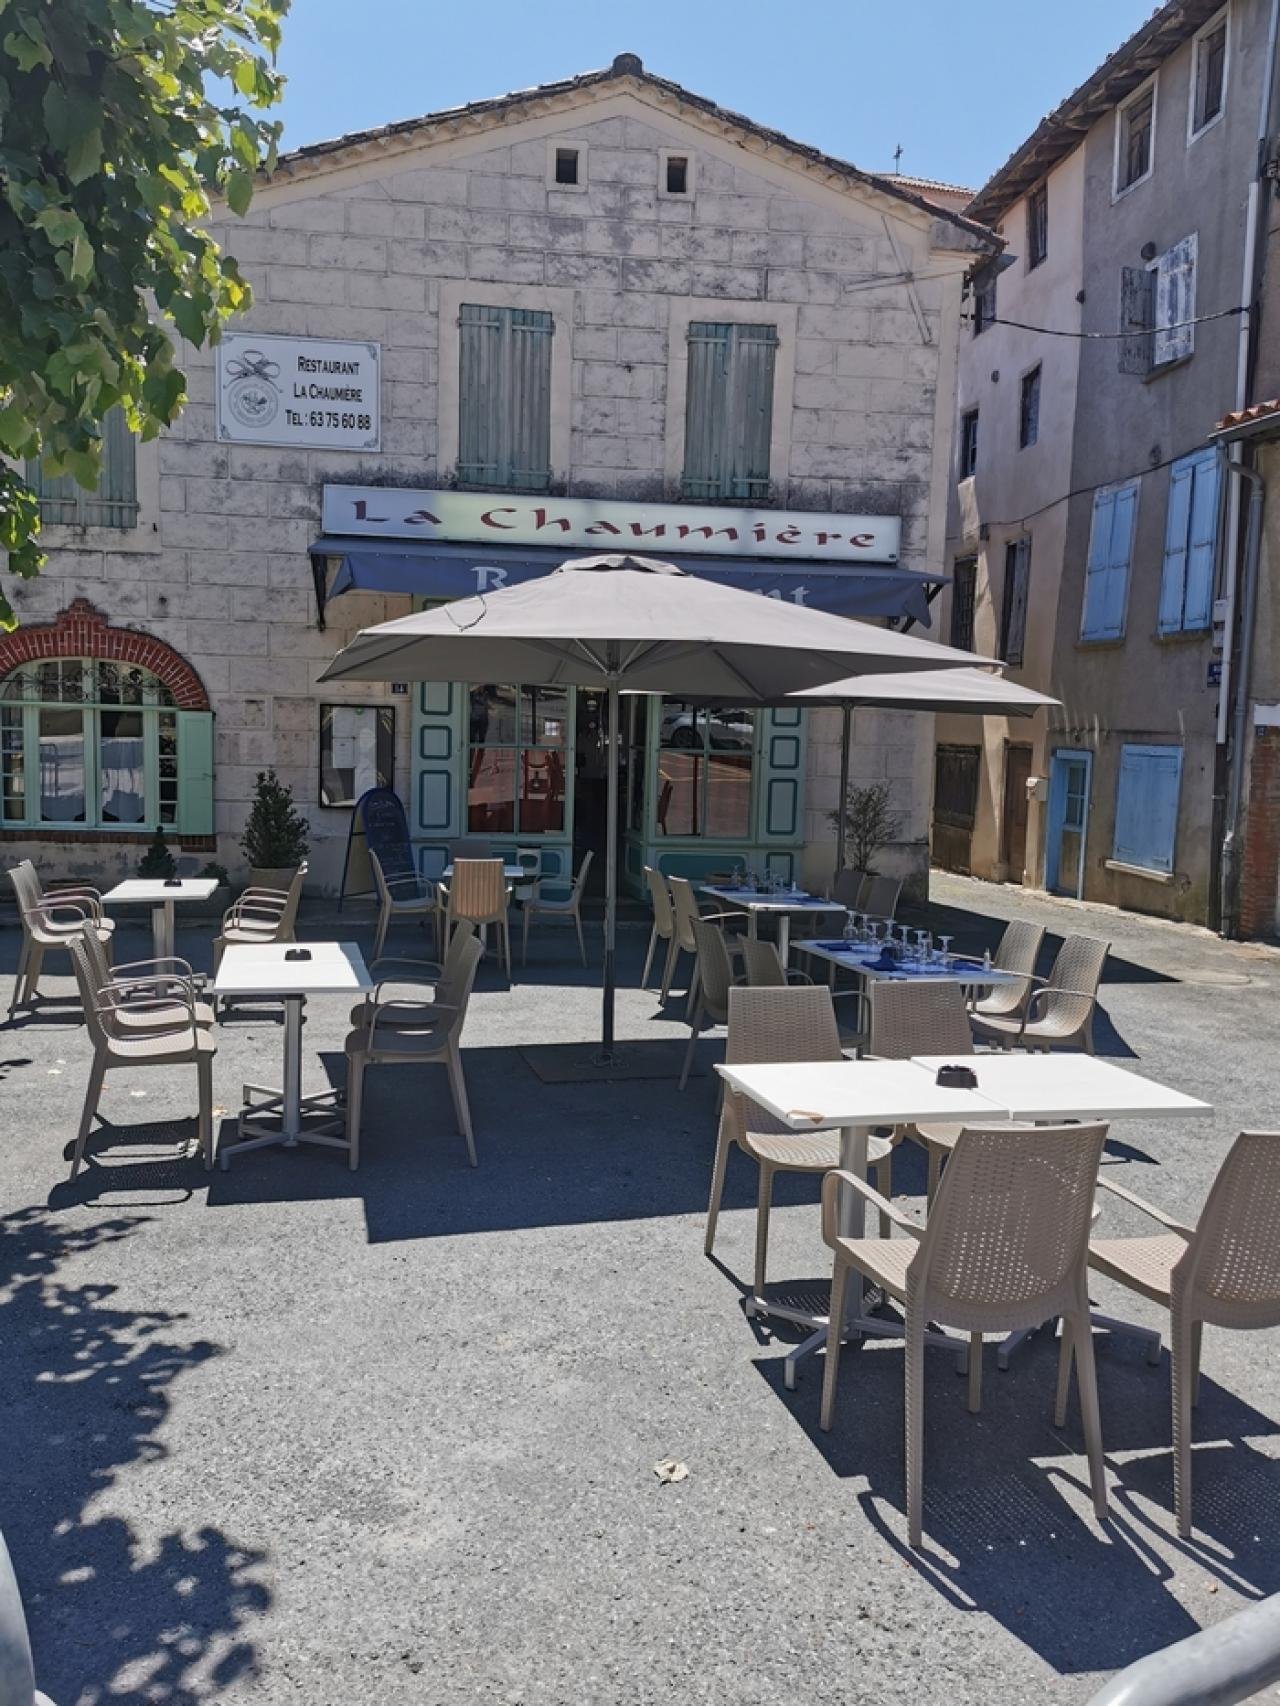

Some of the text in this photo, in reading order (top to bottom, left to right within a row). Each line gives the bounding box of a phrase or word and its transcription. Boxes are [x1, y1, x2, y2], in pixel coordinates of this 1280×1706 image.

[297, 355, 360, 376] RESTAURANT
[293, 381, 307, 399] LA
[310, 410, 324, 427] 63
[325, 412, 339, 429] 75
